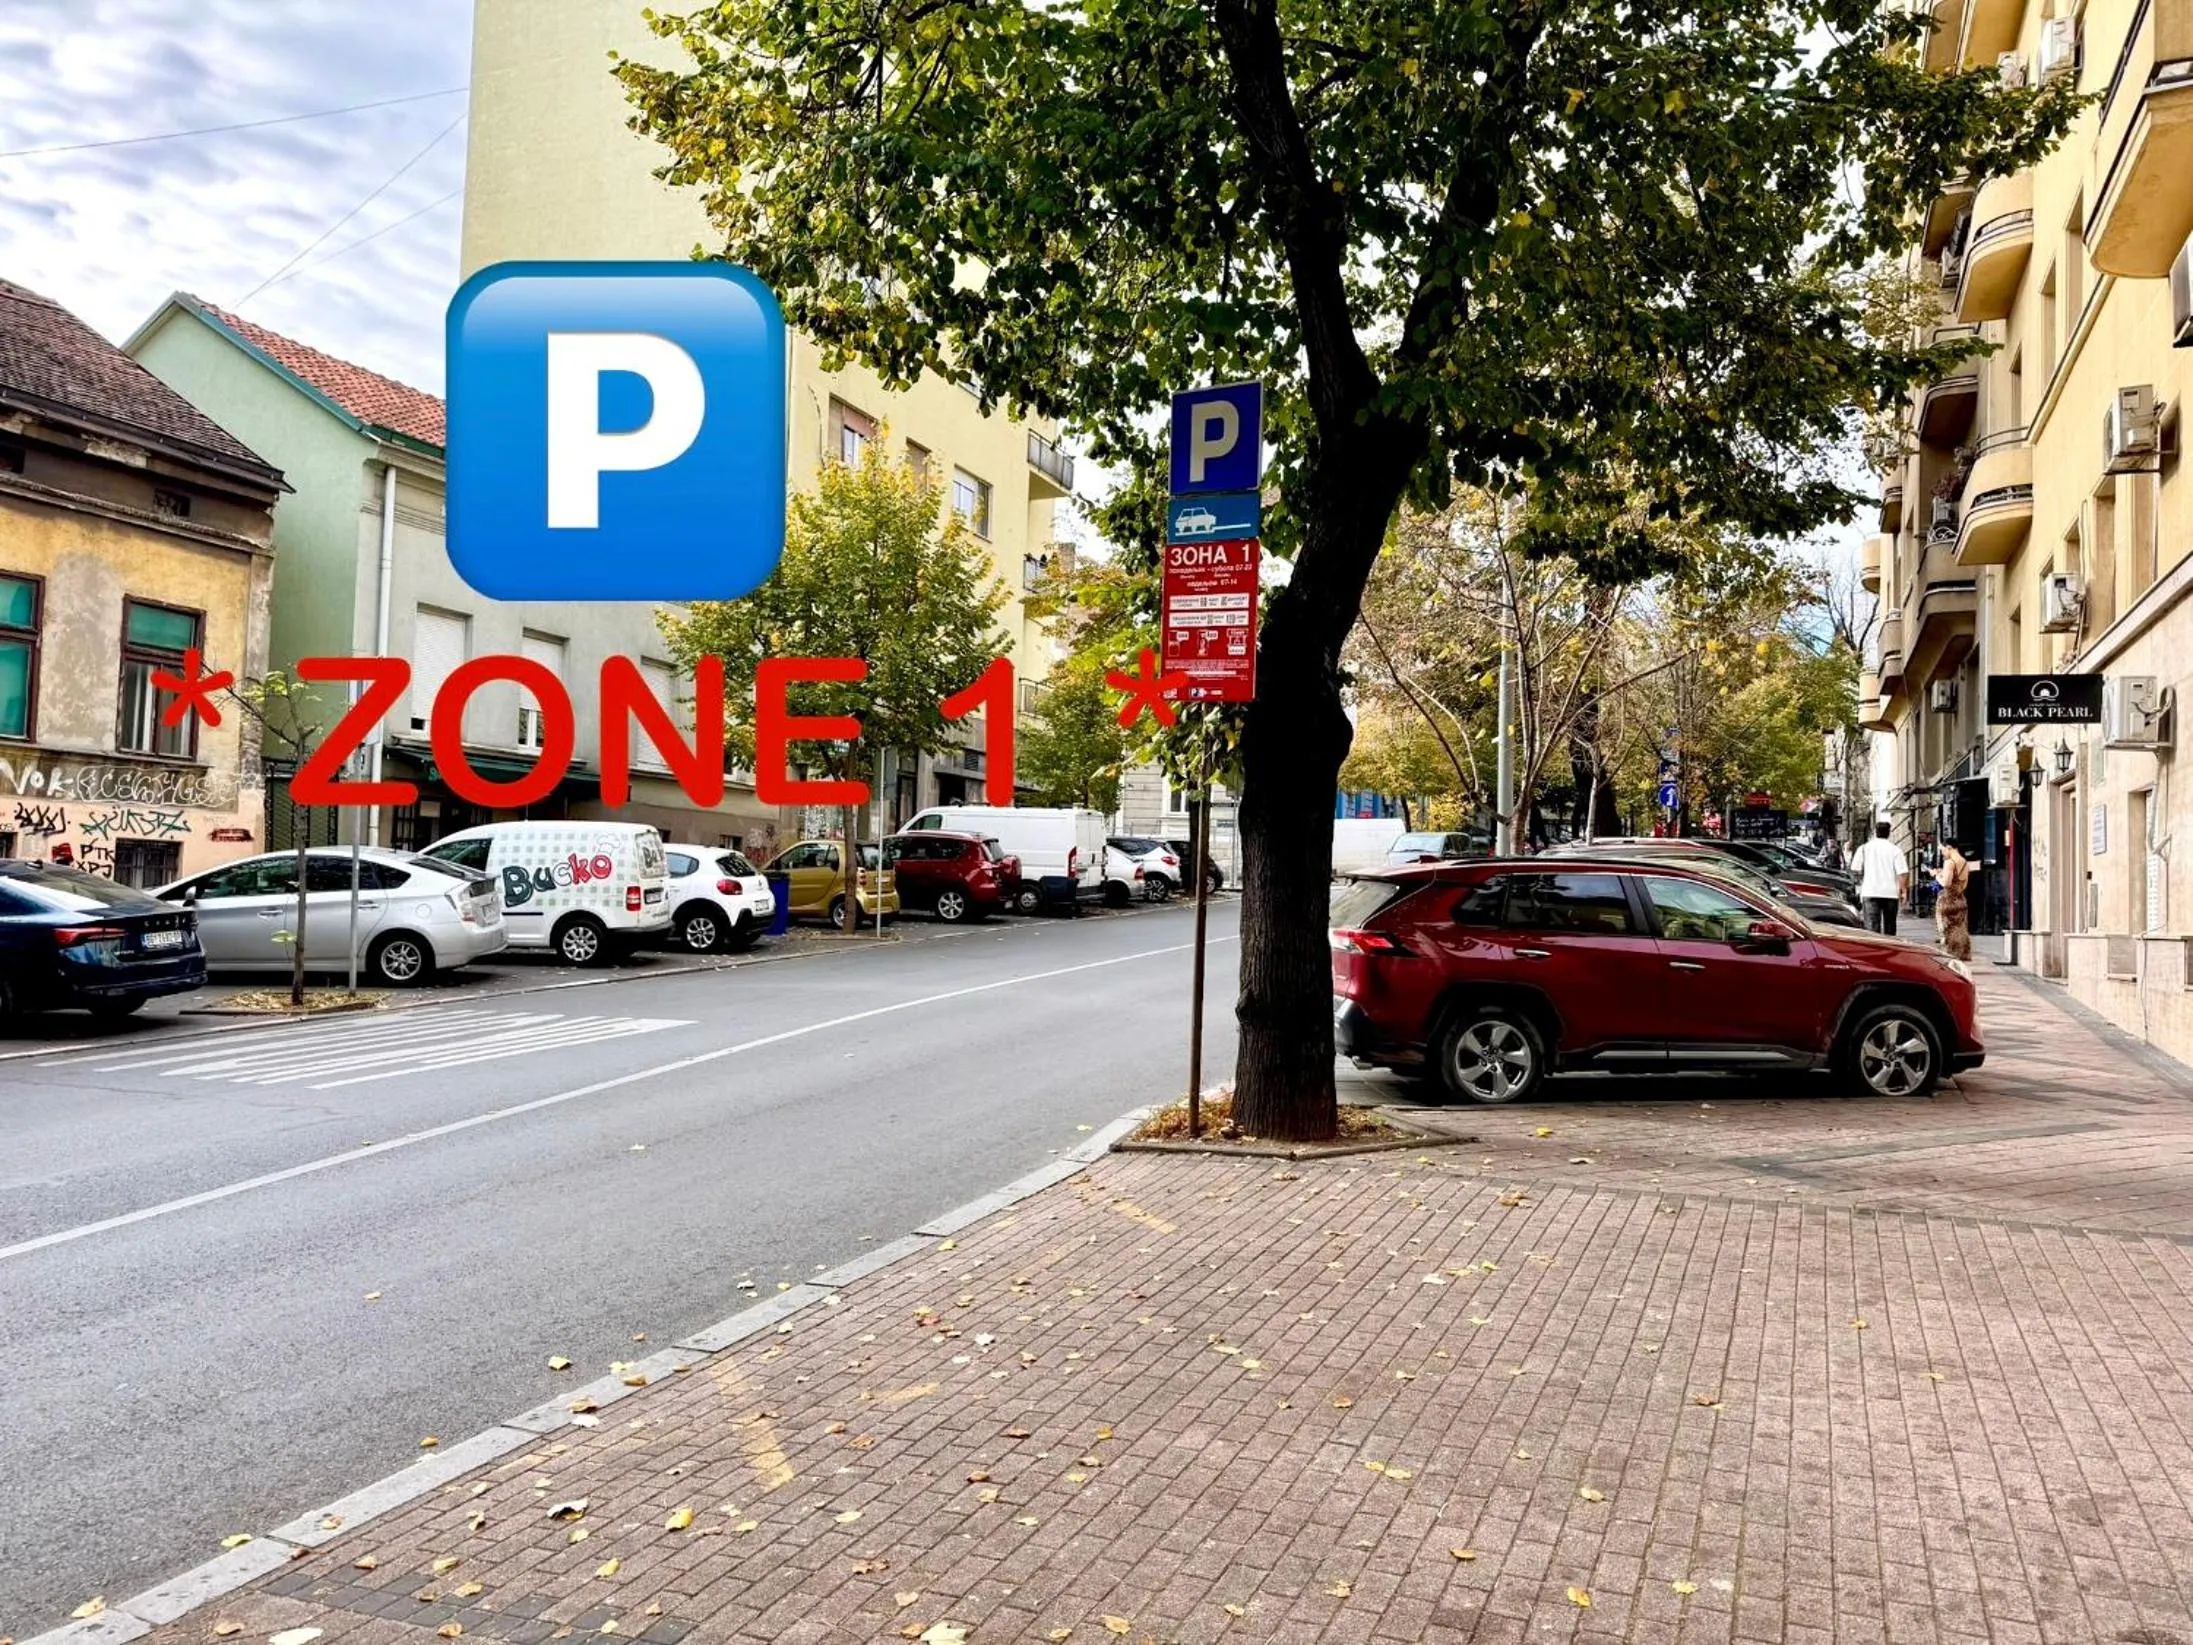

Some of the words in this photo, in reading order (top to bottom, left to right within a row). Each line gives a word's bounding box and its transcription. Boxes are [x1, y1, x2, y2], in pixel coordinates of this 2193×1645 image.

[1189, 400, 1239, 483] P
[1170, 545, 1227, 567] ЗОНА
[1242, 544, 1249, 562] 1
[1998, 707, 2043, 718] BLACK
[2048, 707, 2093, 718] PEARL
